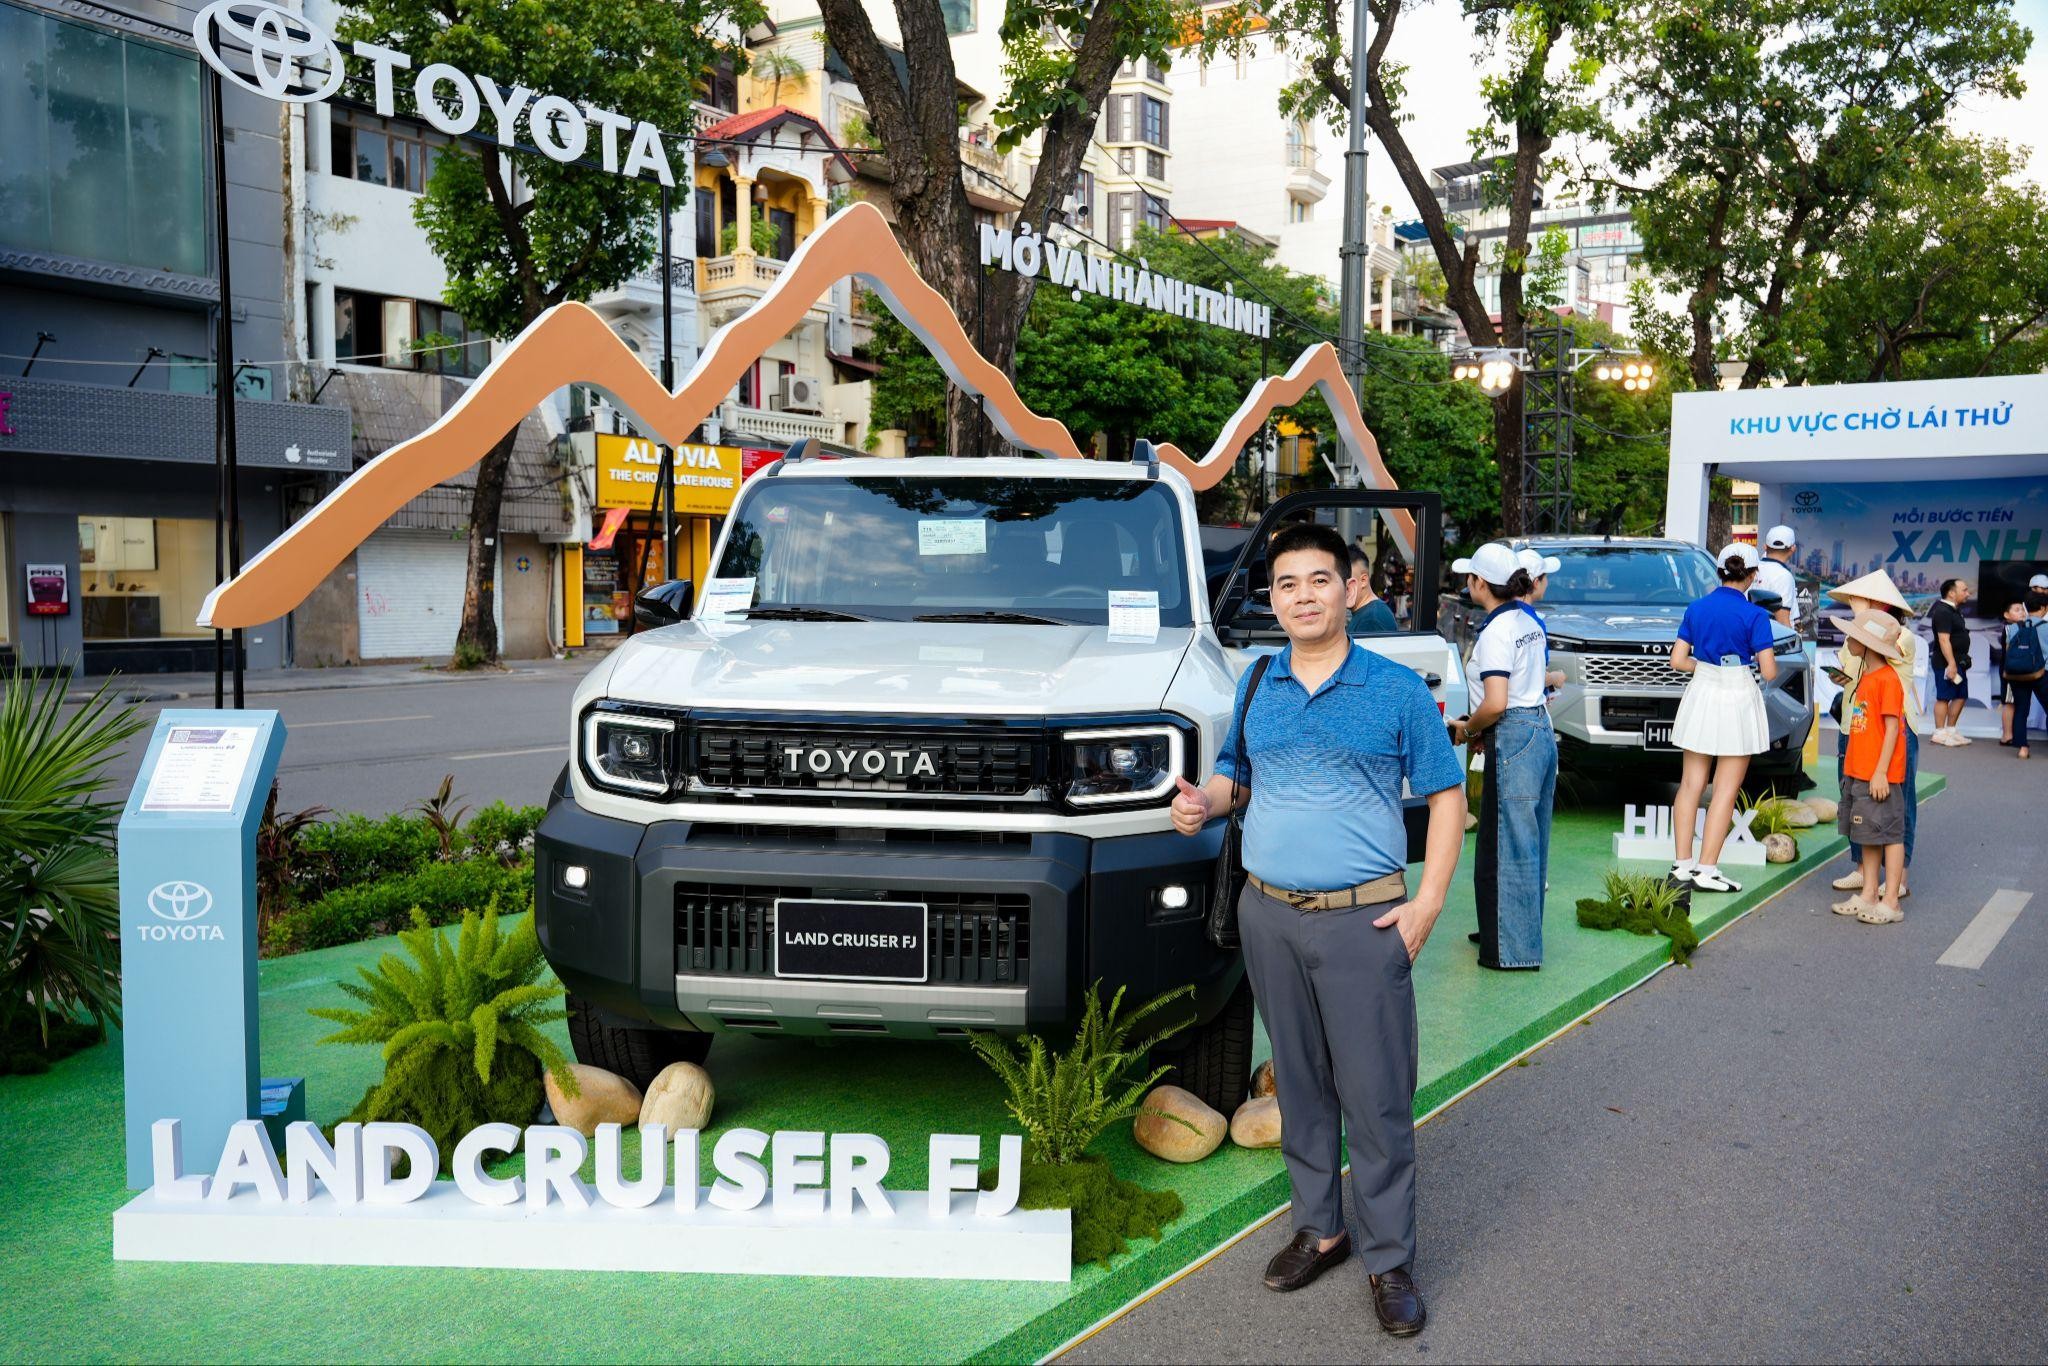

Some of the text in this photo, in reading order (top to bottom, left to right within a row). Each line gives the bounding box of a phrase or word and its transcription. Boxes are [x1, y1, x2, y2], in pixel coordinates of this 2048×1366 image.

[354, 40, 676, 188] TOYOTA
[980, 222, 1271, 339] MỞ VẠN HÀNH TRÌNH
[1730, 401, 2014, 437] KHU VỰC CHỜ LÁI THỬ
[608, 468, 734, 488] THE CHOLATE HOUSE
[1892, 506, 2014, 524] MỖI BƯỚC TIẾN
[1885, 528, 2043, 563] XANH
[784, 749, 936, 776] TOYOTA
[1624, 803, 1759, 845] HIX
[137, 925, 225, 941] TOYOTA
[785, 931, 917, 949] LAND CRUISER FJ
[152, 1118, 1023, 1217] LAND CRUISER FJ
